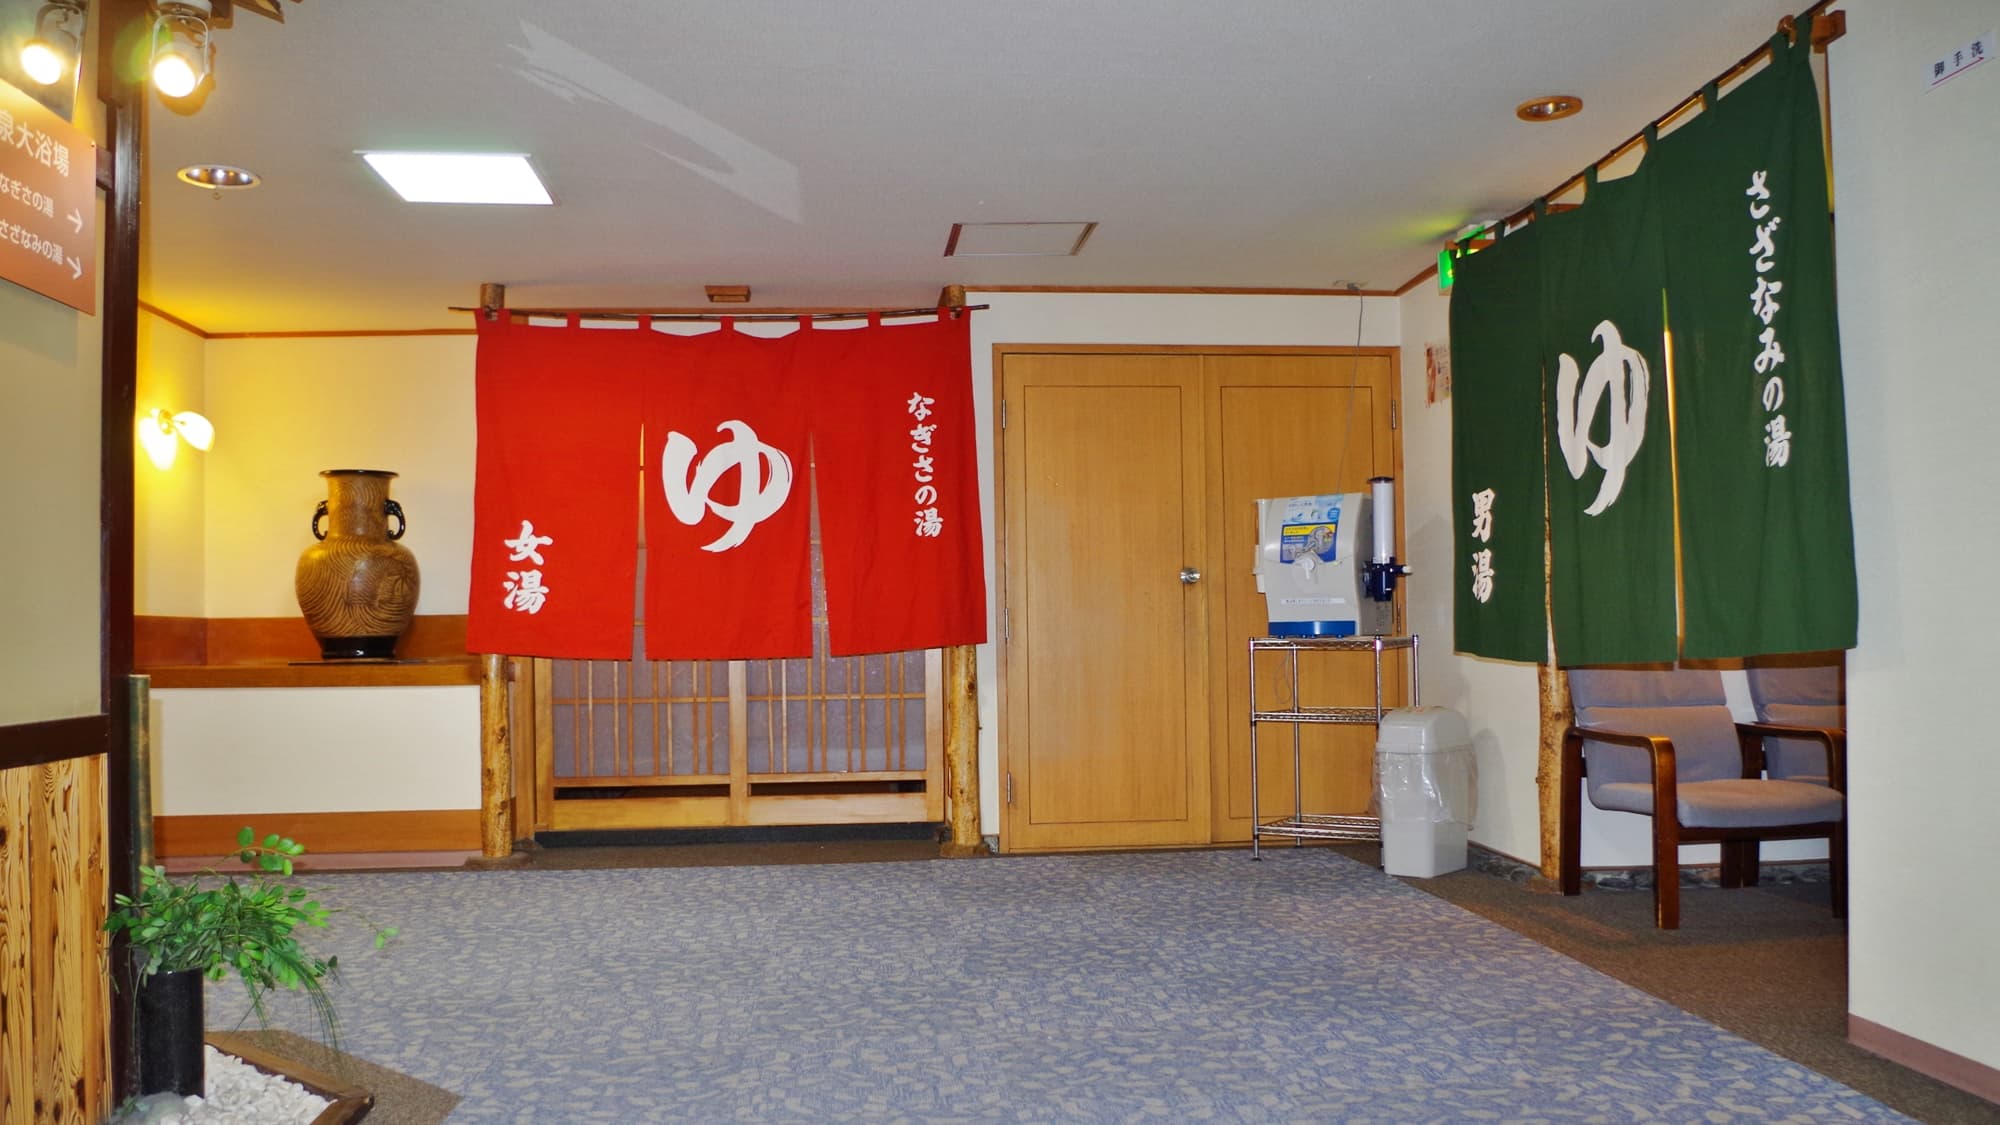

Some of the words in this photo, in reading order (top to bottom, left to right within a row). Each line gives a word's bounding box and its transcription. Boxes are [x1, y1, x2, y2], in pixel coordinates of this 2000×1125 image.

[1745, 170, 1793, 468] さざなみの湯
[661, 419, 794, 553] ゆ
[906, 391, 945, 538] なぎさの湯
[1556, 319, 1650, 517] ゆ
[502, 519, 554, 615] 女湯
[1471, 487, 1496, 605] 男湯
